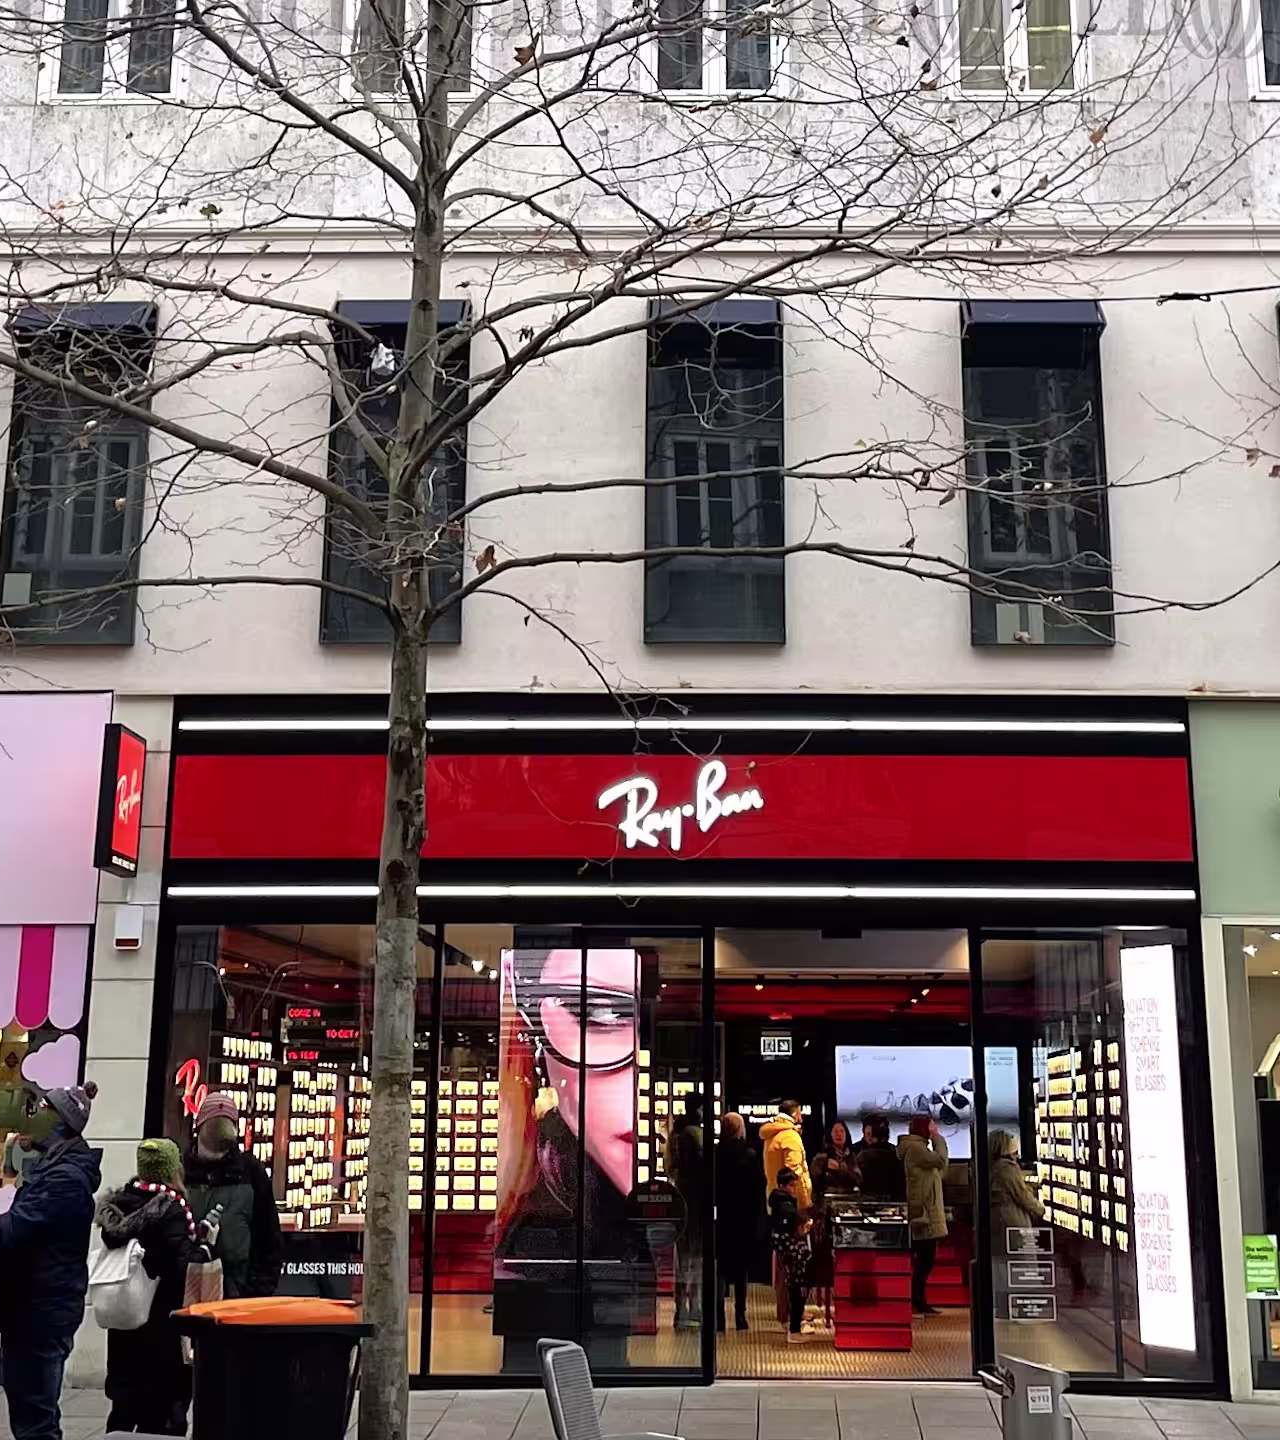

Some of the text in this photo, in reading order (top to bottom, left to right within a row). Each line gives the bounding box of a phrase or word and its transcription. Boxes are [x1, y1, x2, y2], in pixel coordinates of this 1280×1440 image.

[286, 1262, 326, 1274] GLASSES
[327, 1262, 347, 1274] THIS
[348, 1262, 365, 1274] HOL
